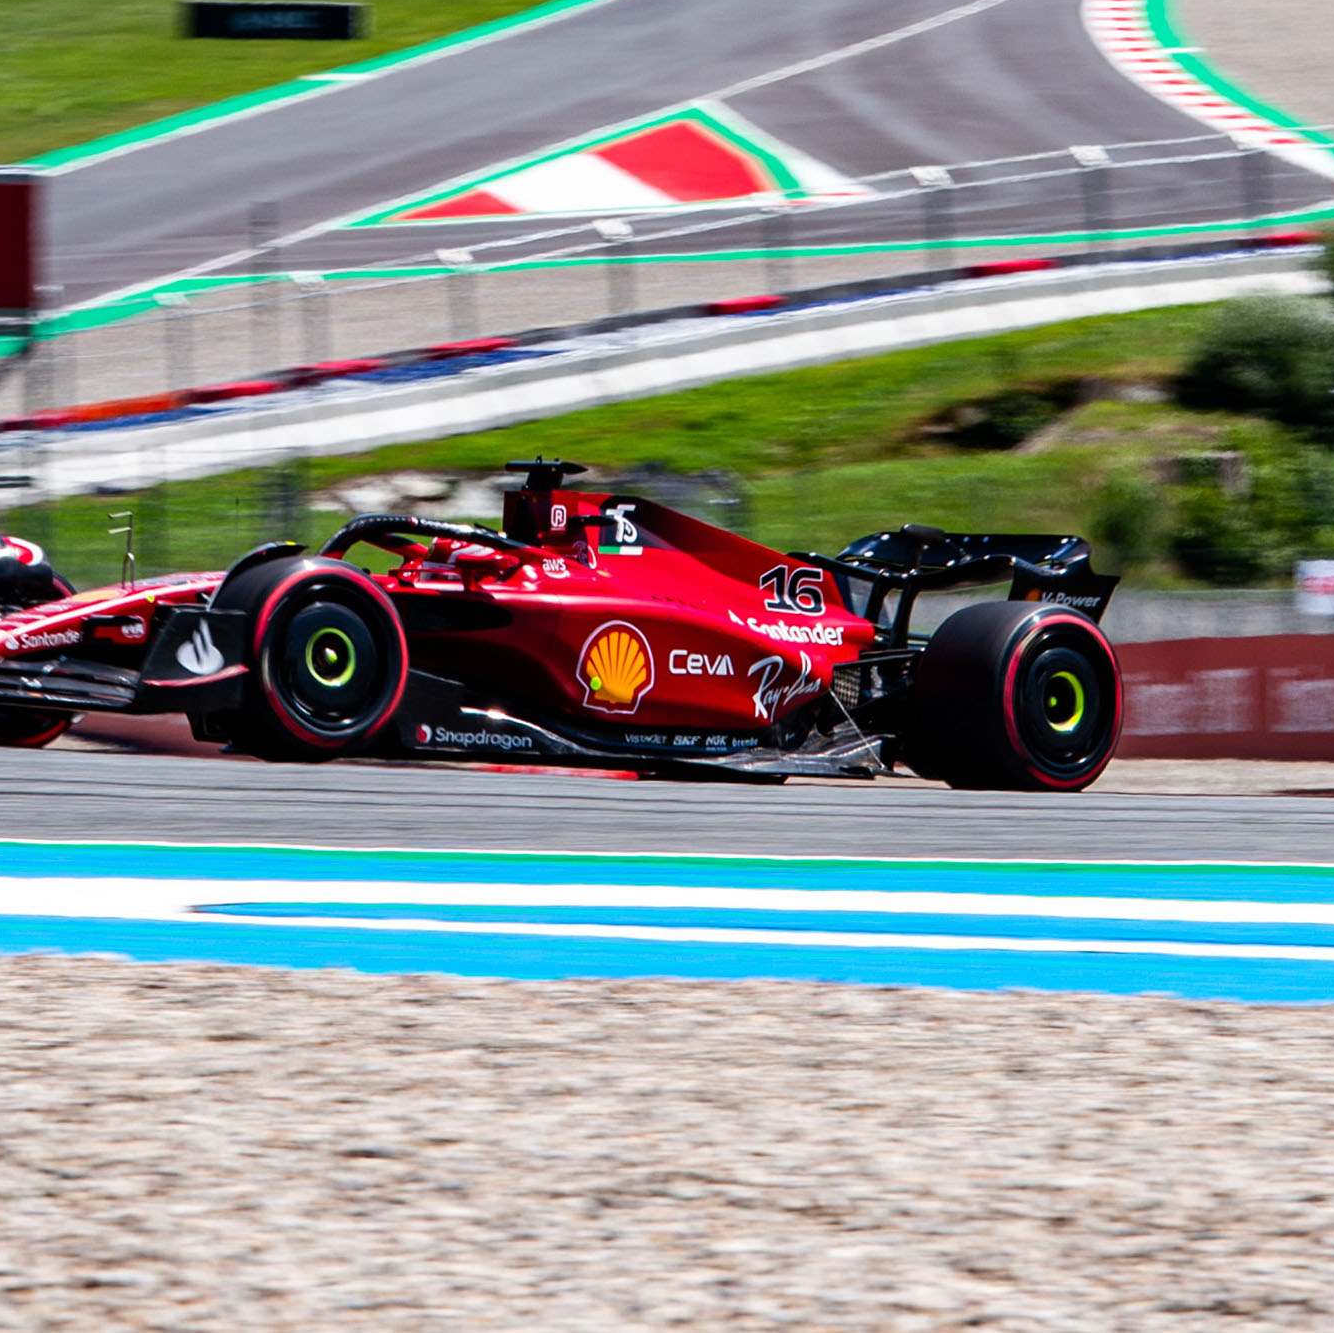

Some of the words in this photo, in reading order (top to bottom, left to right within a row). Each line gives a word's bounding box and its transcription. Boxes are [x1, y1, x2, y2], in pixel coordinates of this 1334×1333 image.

[542, 558, 566, 571] aws
[759, 564, 826, 616] 16
[20, 628, 83, 649] Santander
[747, 617, 844, 646] Santander
[435, 726, 532, 750] Snapdragon
